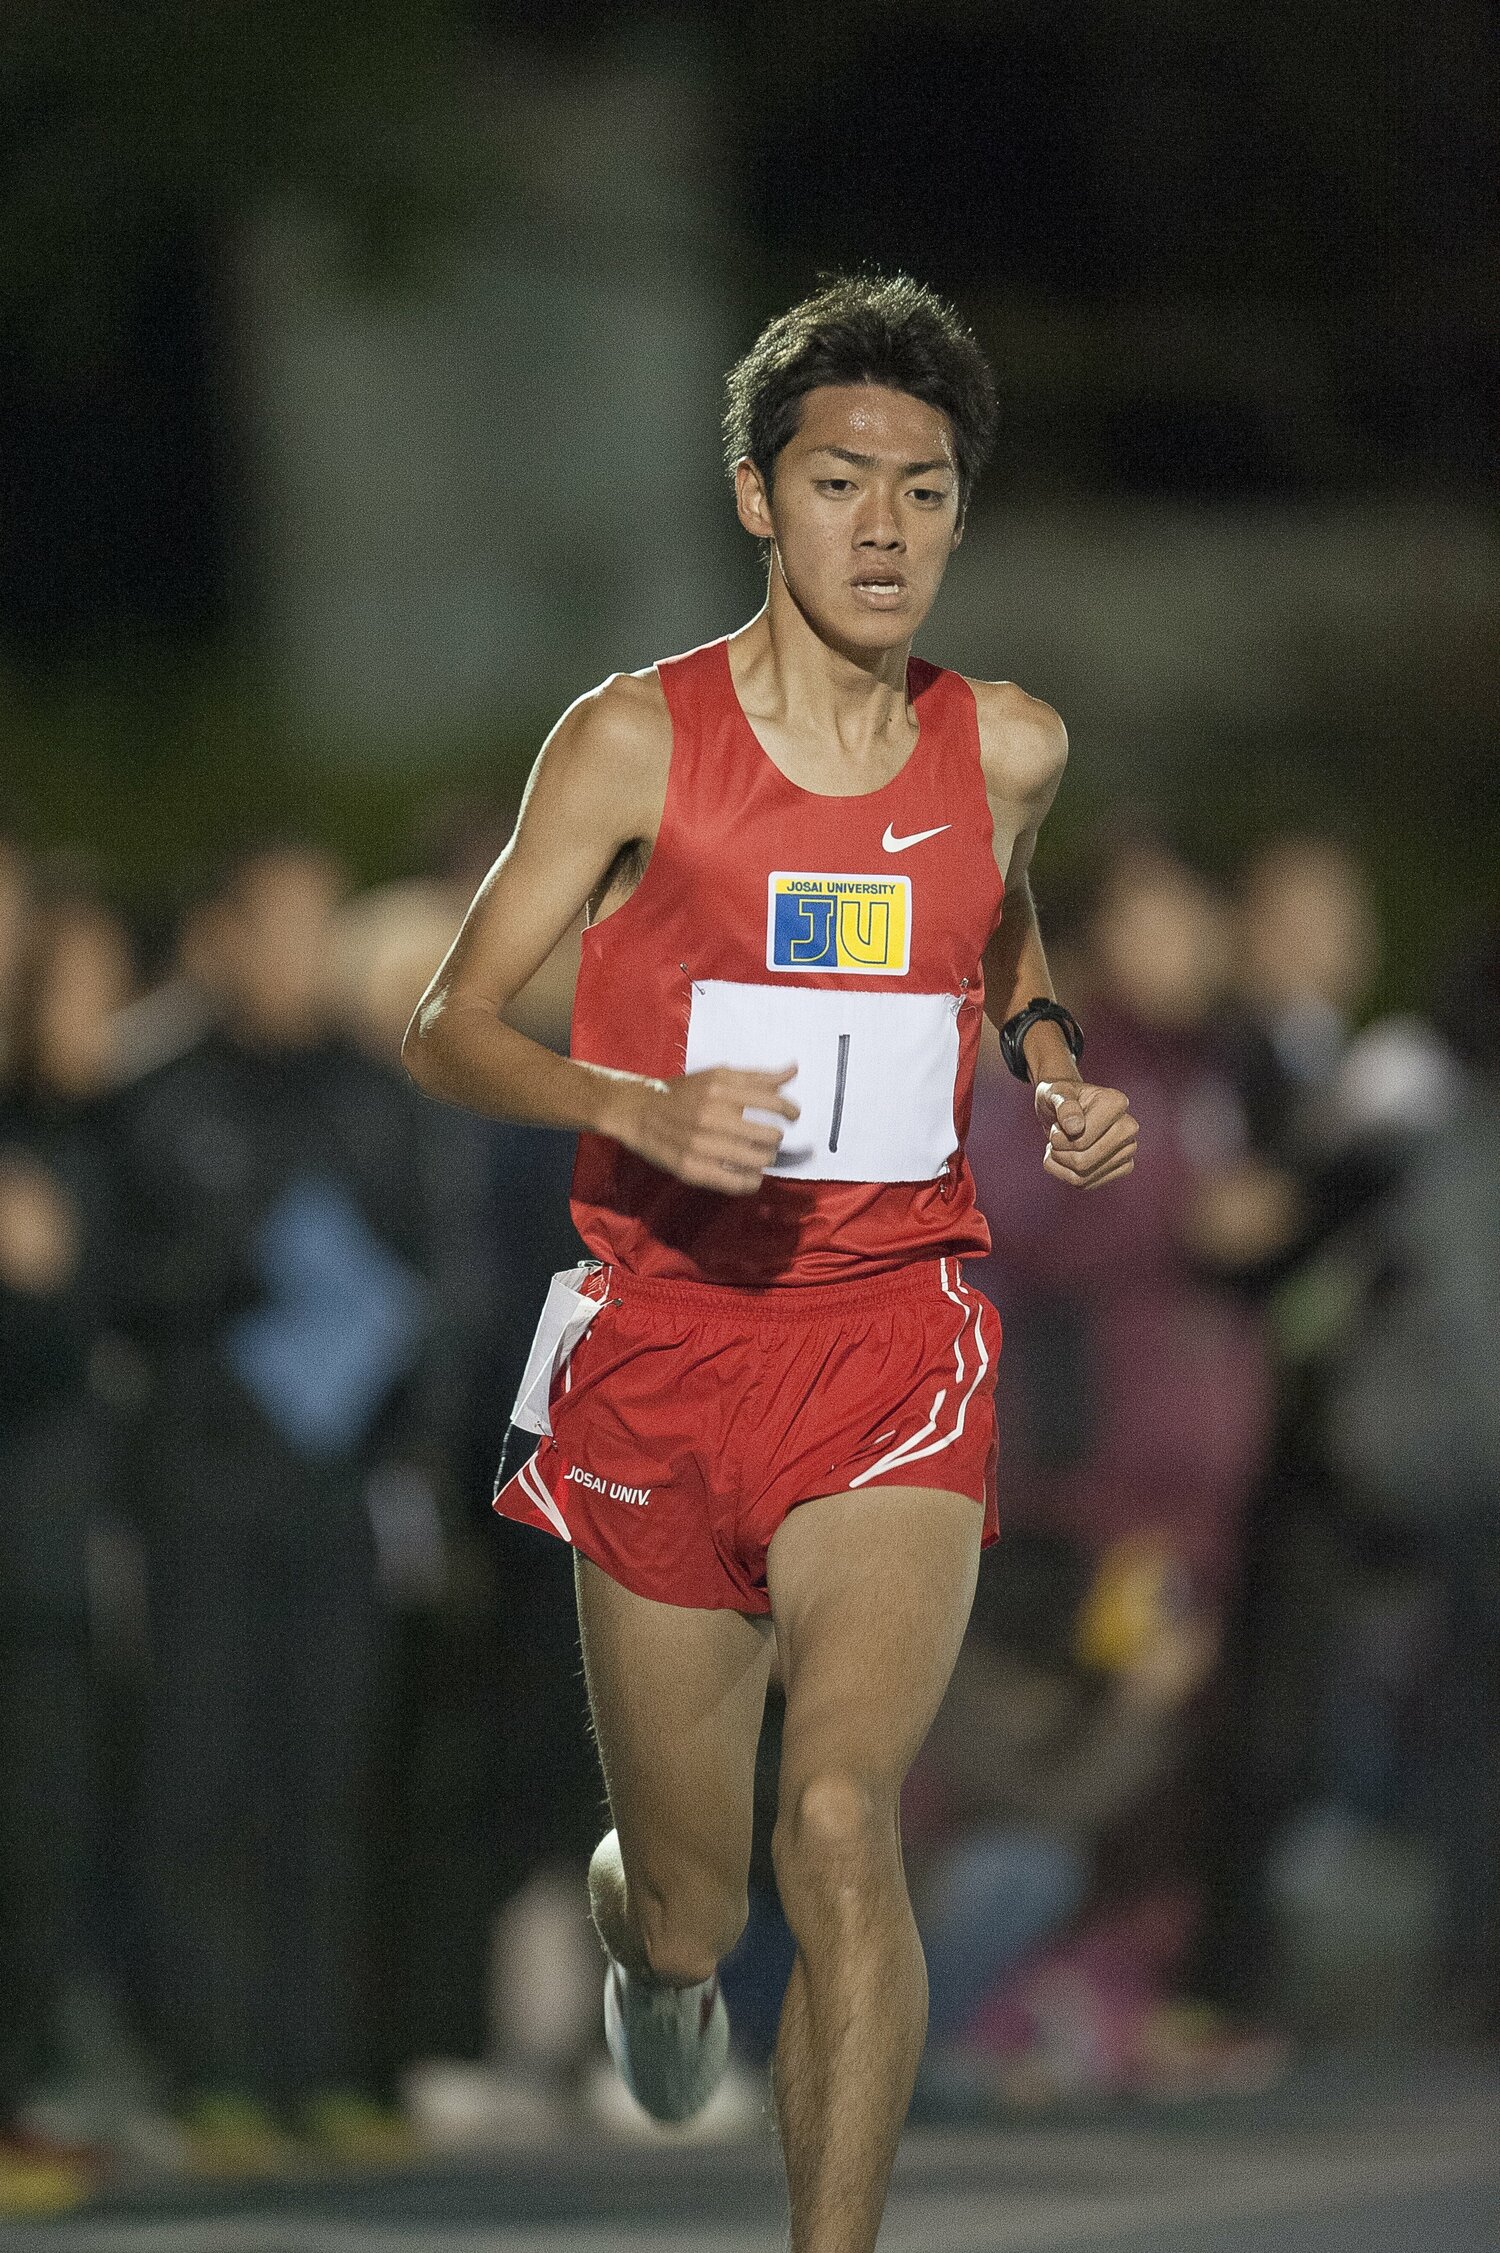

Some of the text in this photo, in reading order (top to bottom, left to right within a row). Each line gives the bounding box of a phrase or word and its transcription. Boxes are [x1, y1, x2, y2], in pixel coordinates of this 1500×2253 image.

[786, 881, 896, 895] JOSAI UNIVERSITY
[790, 898, 890, 964] JU
[564, 1465, 651, 1506] JOSAI UNIV.
